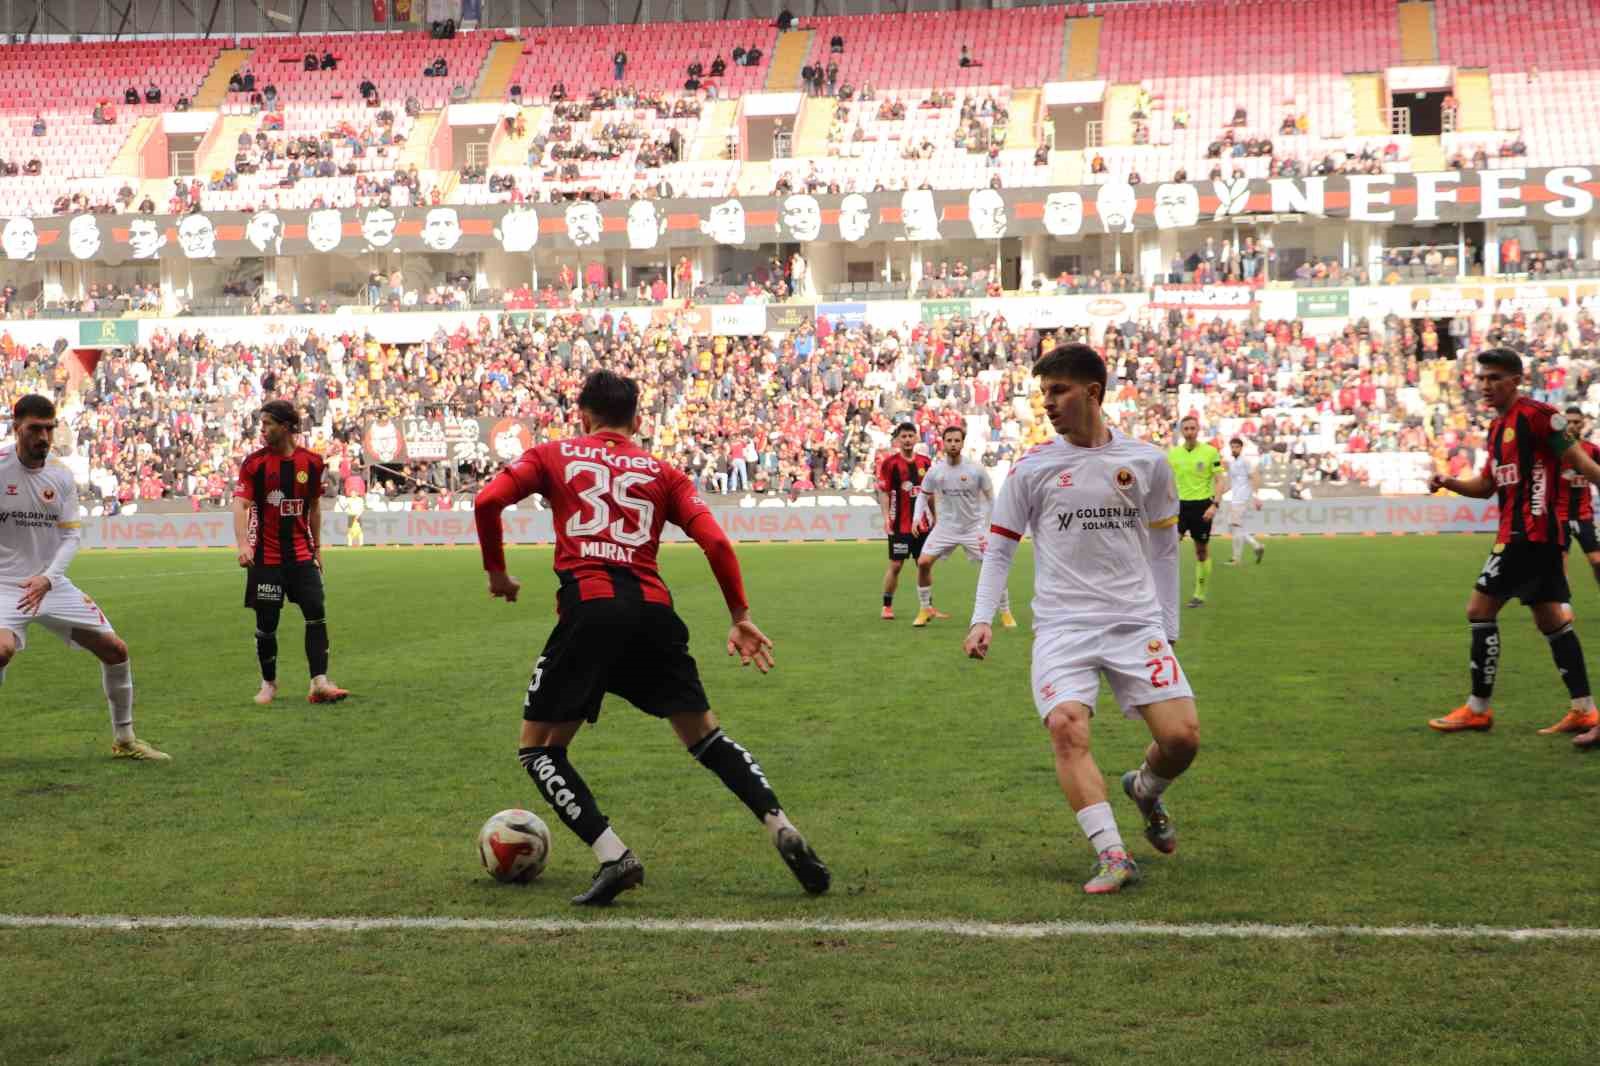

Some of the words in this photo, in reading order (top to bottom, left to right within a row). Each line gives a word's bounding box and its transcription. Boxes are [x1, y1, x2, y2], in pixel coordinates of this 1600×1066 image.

[1270, 167, 1593, 222] NEFES
[560, 442, 661, 473] turknet
[565, 460, 656, 547] 35
[1076, 508, 1121, 519] GOLDEN
[580, 541, 636, 563] MURAT
[1145, 655, 1180, 688] 27
